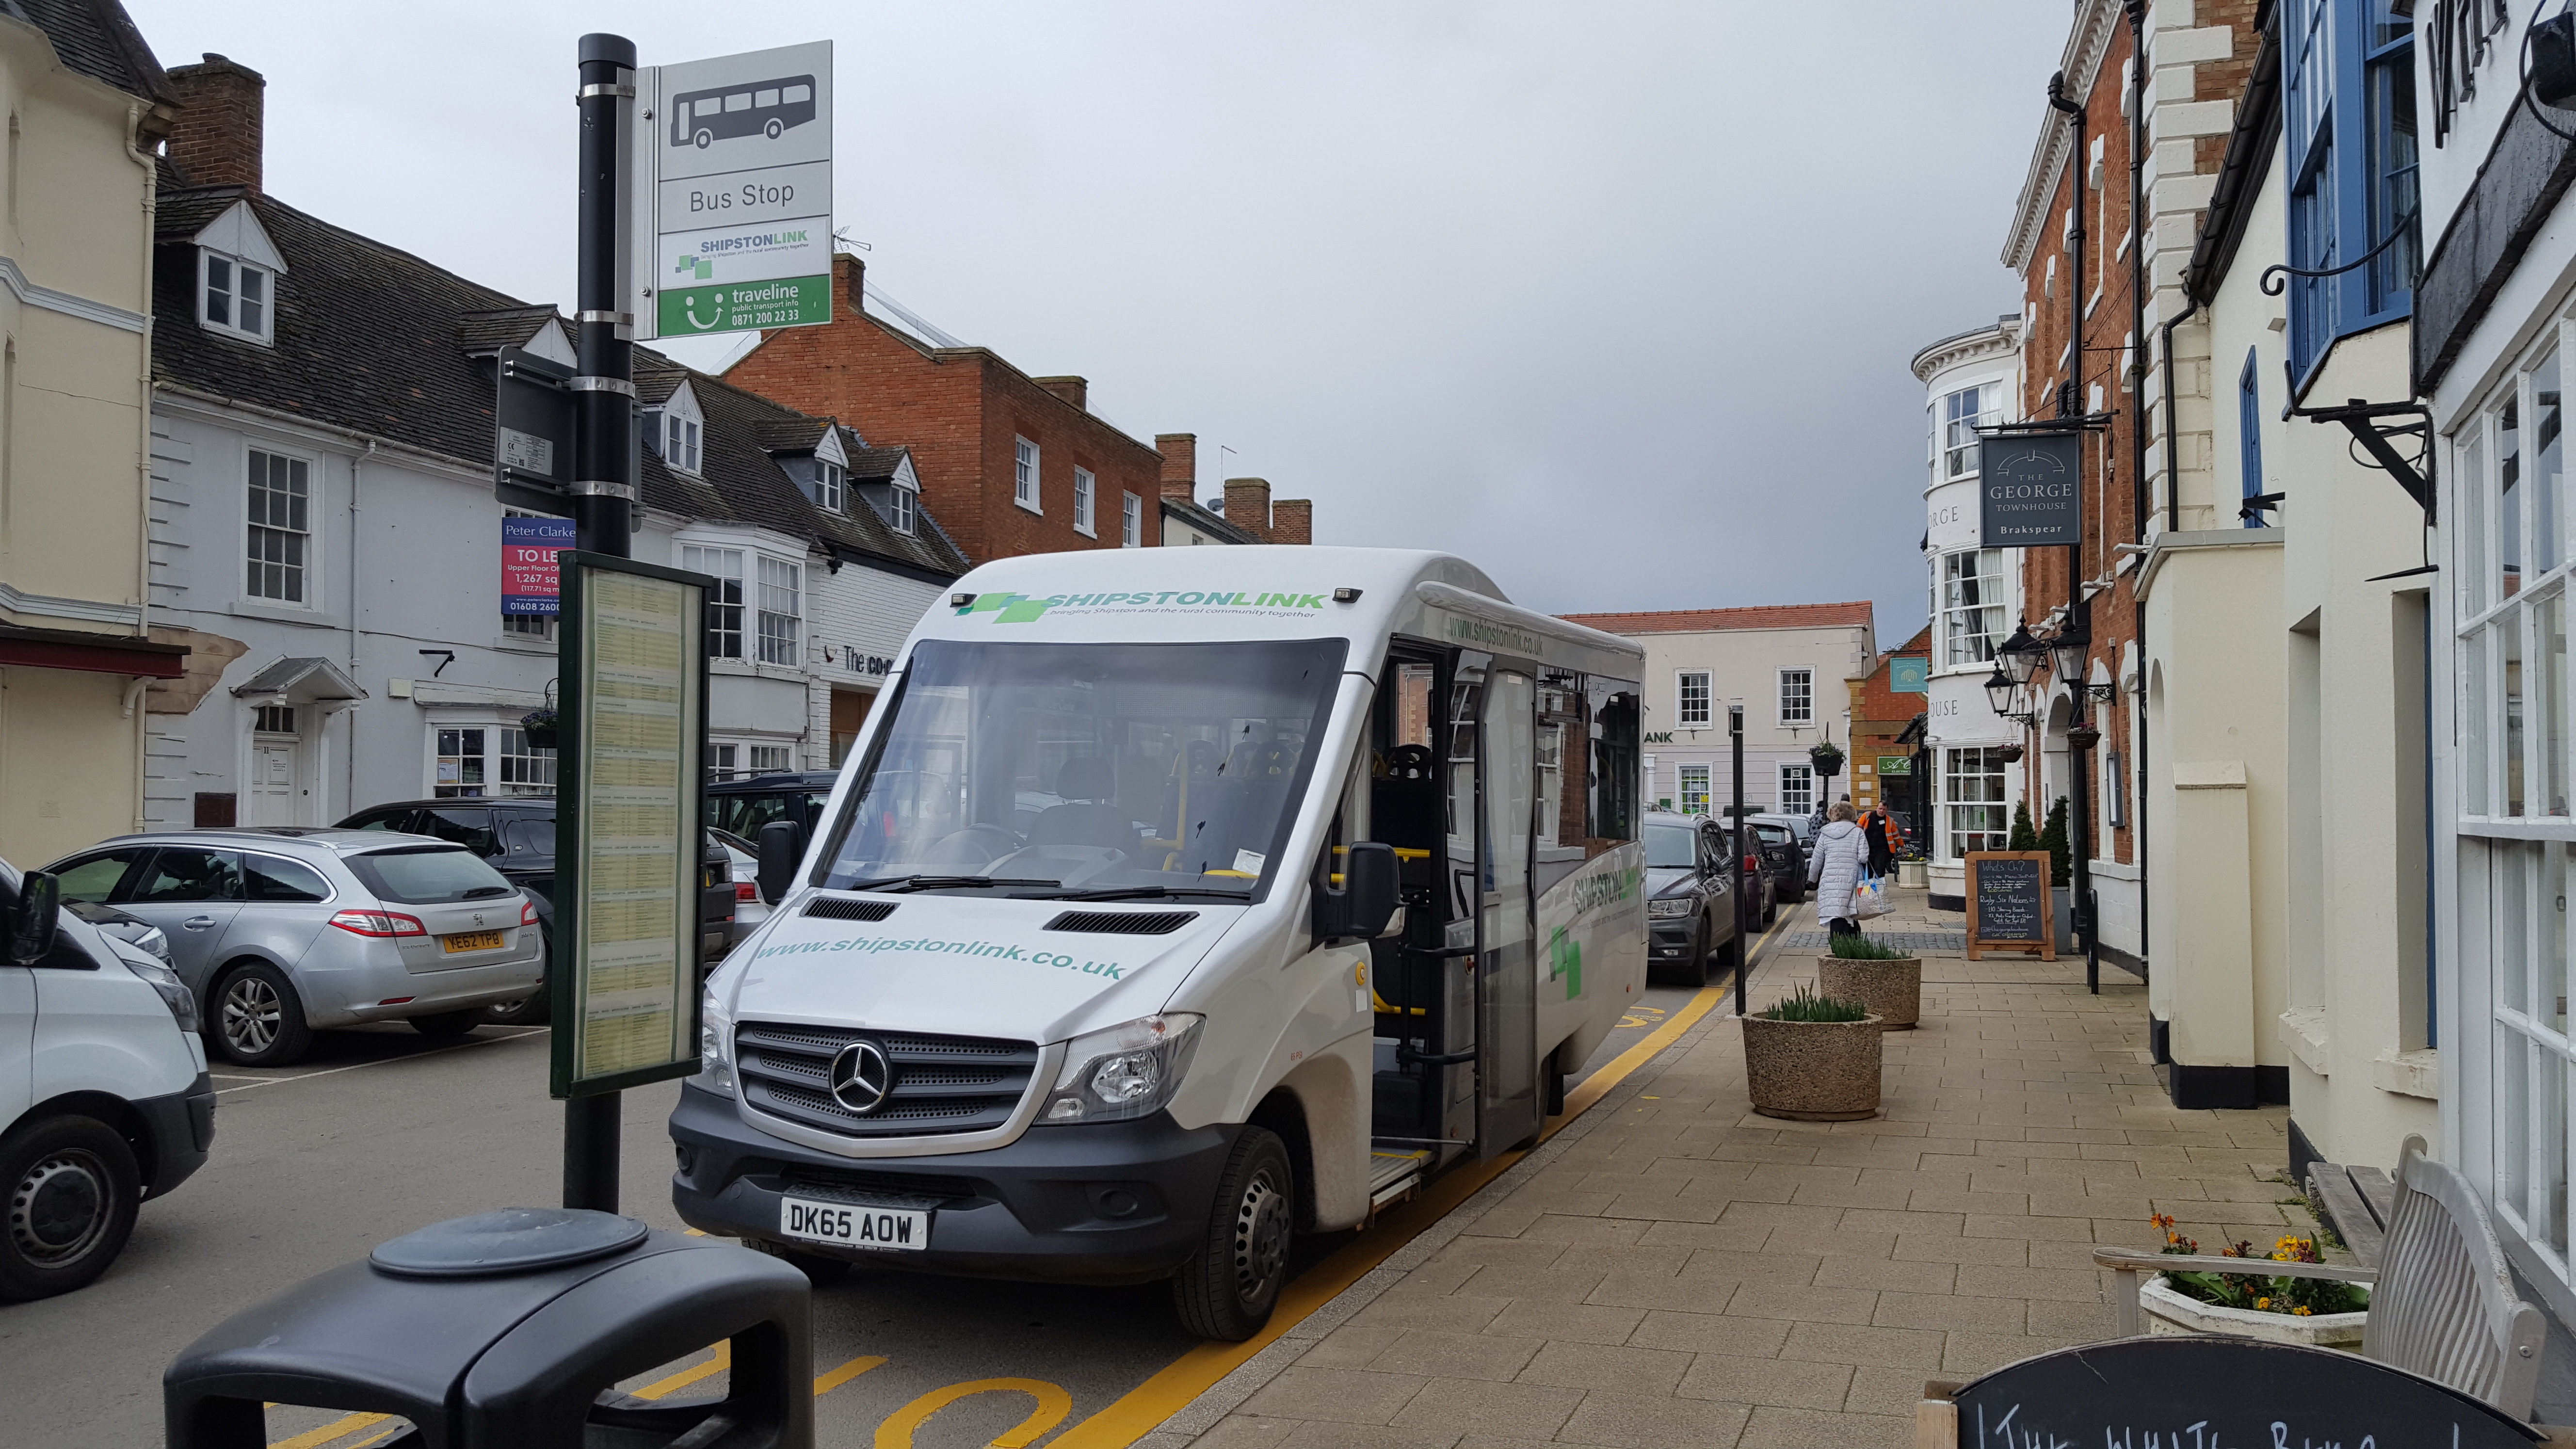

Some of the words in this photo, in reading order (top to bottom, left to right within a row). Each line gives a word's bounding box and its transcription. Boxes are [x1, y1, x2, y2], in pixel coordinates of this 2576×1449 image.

[691, 191, 732, 212] Bus
[742, 184, 794, 207] Stop
[701, 230, 807, 253] SHIPSTONLINK
[732, 283, 799, 304] traveline
[732, 304, 752, 314] public
[754, 300, 784, 311] transport
[786, 299, 799, 307] info
[732, 314, 752, 326] 0871
[756, 312, 772, 324] 200
[775, 310, 785, 322] 22
[788, 309, 799, 321] 33
[1990, 483, 2072, 499] GEORGE
[1996, 502, 2066, 512] TOWNHOUSE
[506, 525, 535, 536] Peter
[539, 526, 576, 537] Clarke
[2000, 526, 2062, 535] Brakspear
[517, 549, 538, 562] TO
[515, 574, 542, 583] 1,267
[545, 576, 558, 585] sq
[510, 602, 537, 611] 01608
[1042, 591, 1327, 609] SHIPSTONLINK
[1449, 616, 1543, 657] www.shipstonlink.co.uk
[844, 645, 864, 673] The
[1929, 700, 1959, 718] OUSE
[1996, 894, 2007, 902] Six
[448, 934, 478, 949] YE62
[757, 937, 1127, 980] www.shipstonlink.co.uk
[790, 1204, 852, 1238] DK65
[860, 1213, 913, 1243] AOW
